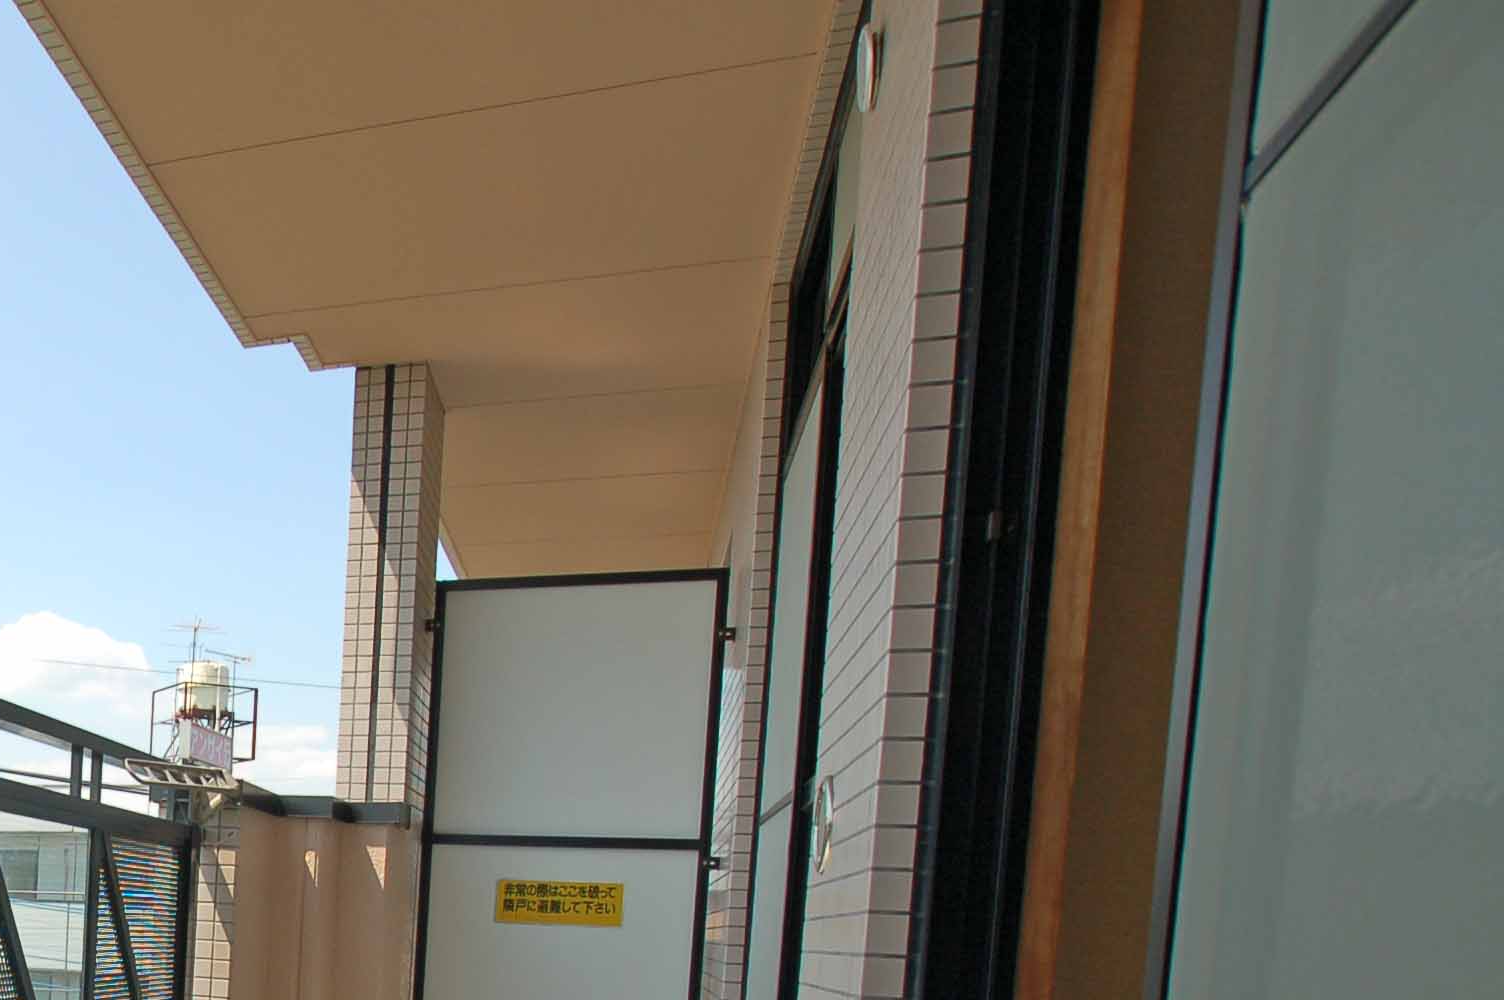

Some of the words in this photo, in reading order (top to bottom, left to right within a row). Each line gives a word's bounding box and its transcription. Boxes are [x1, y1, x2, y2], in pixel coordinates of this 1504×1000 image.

[503, 883, 617, 899] 非常の際はここを破って
